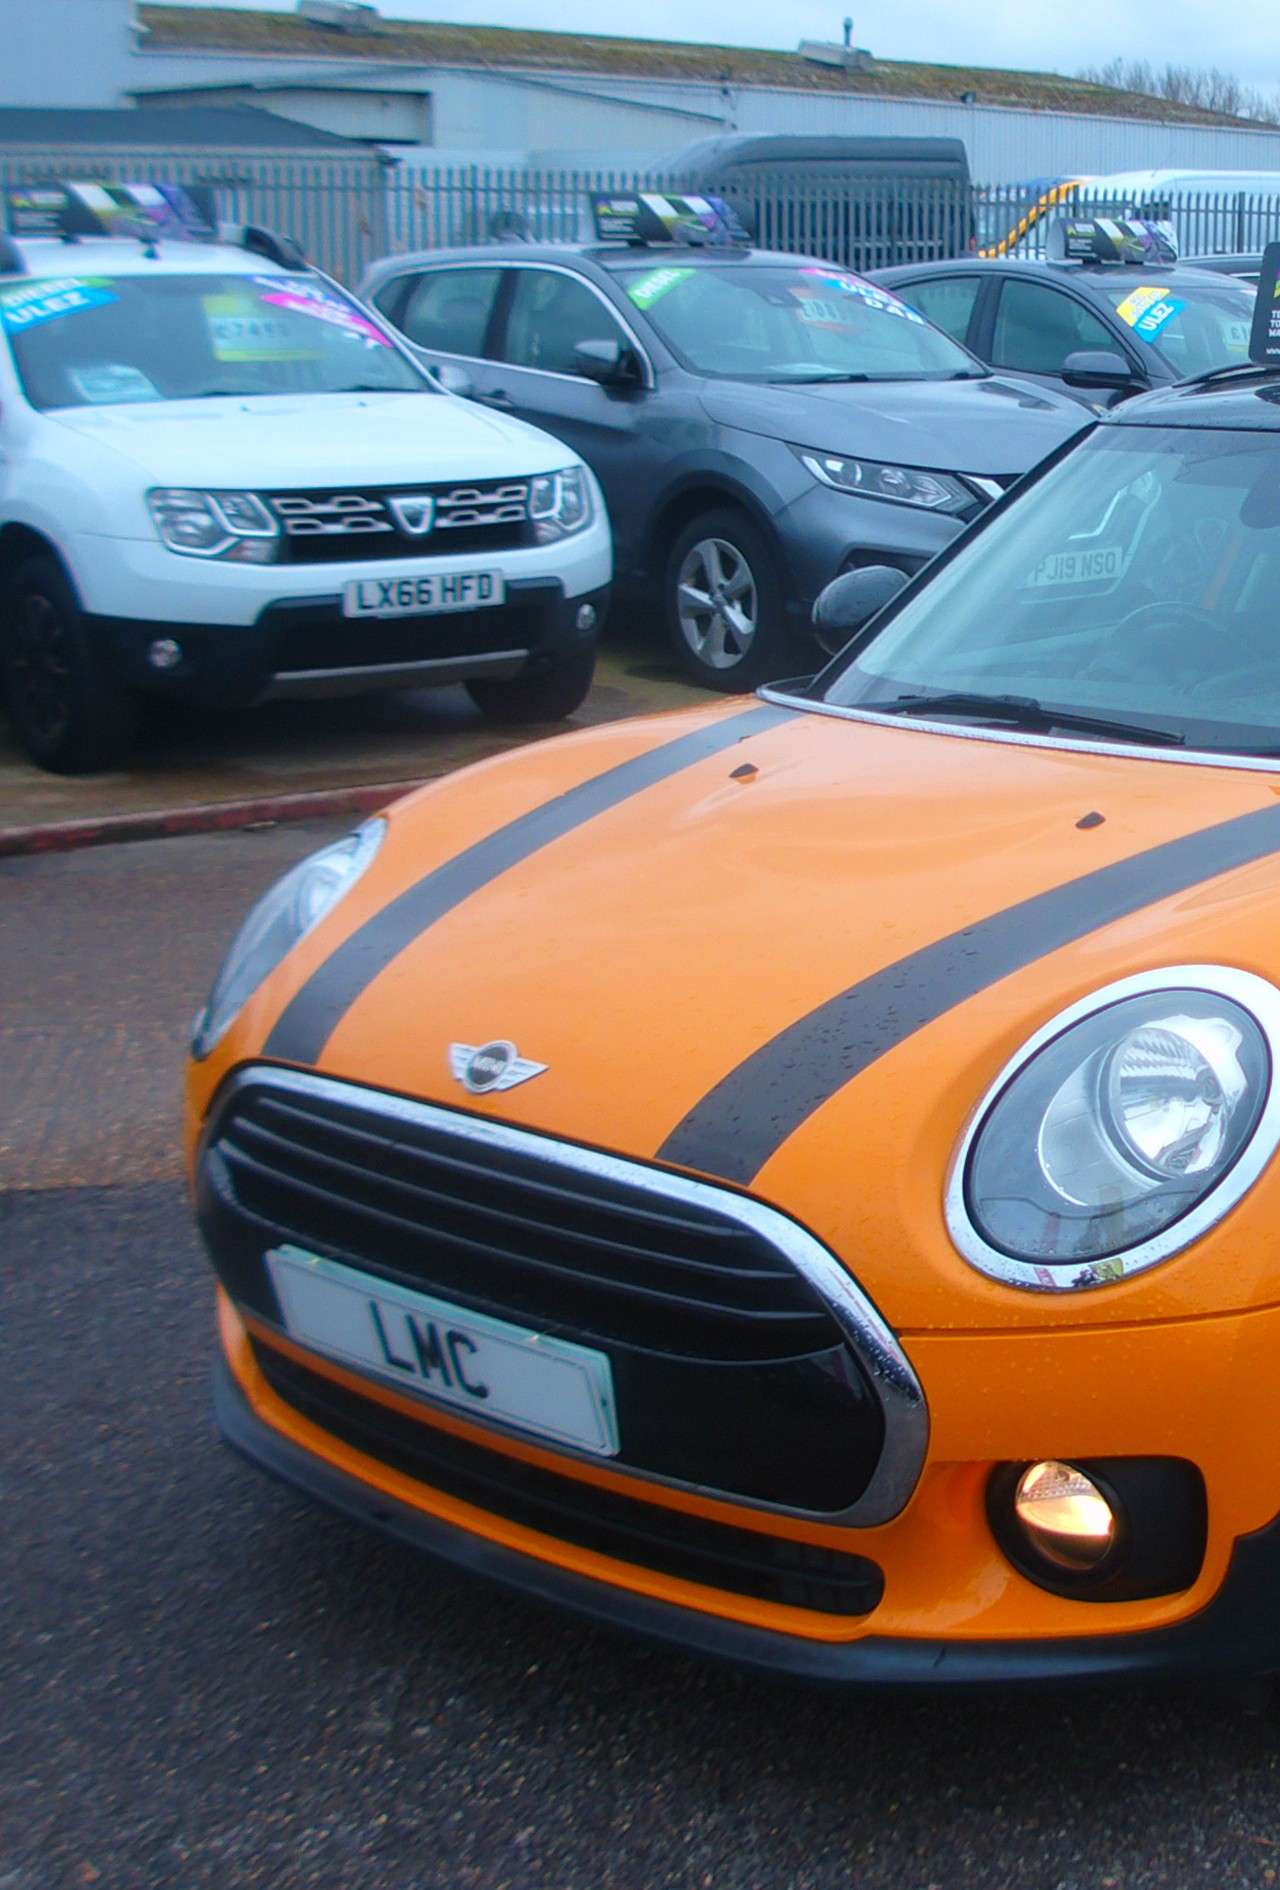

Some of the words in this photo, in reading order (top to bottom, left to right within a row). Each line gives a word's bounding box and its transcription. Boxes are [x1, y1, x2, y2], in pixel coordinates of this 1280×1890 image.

[1138, 302, 1175, 331] ULEZ
[357, 579, 433, 609] LX66
[441, 573, 493, 603] HFD
[368, 1299, 489, 1399] LMC
